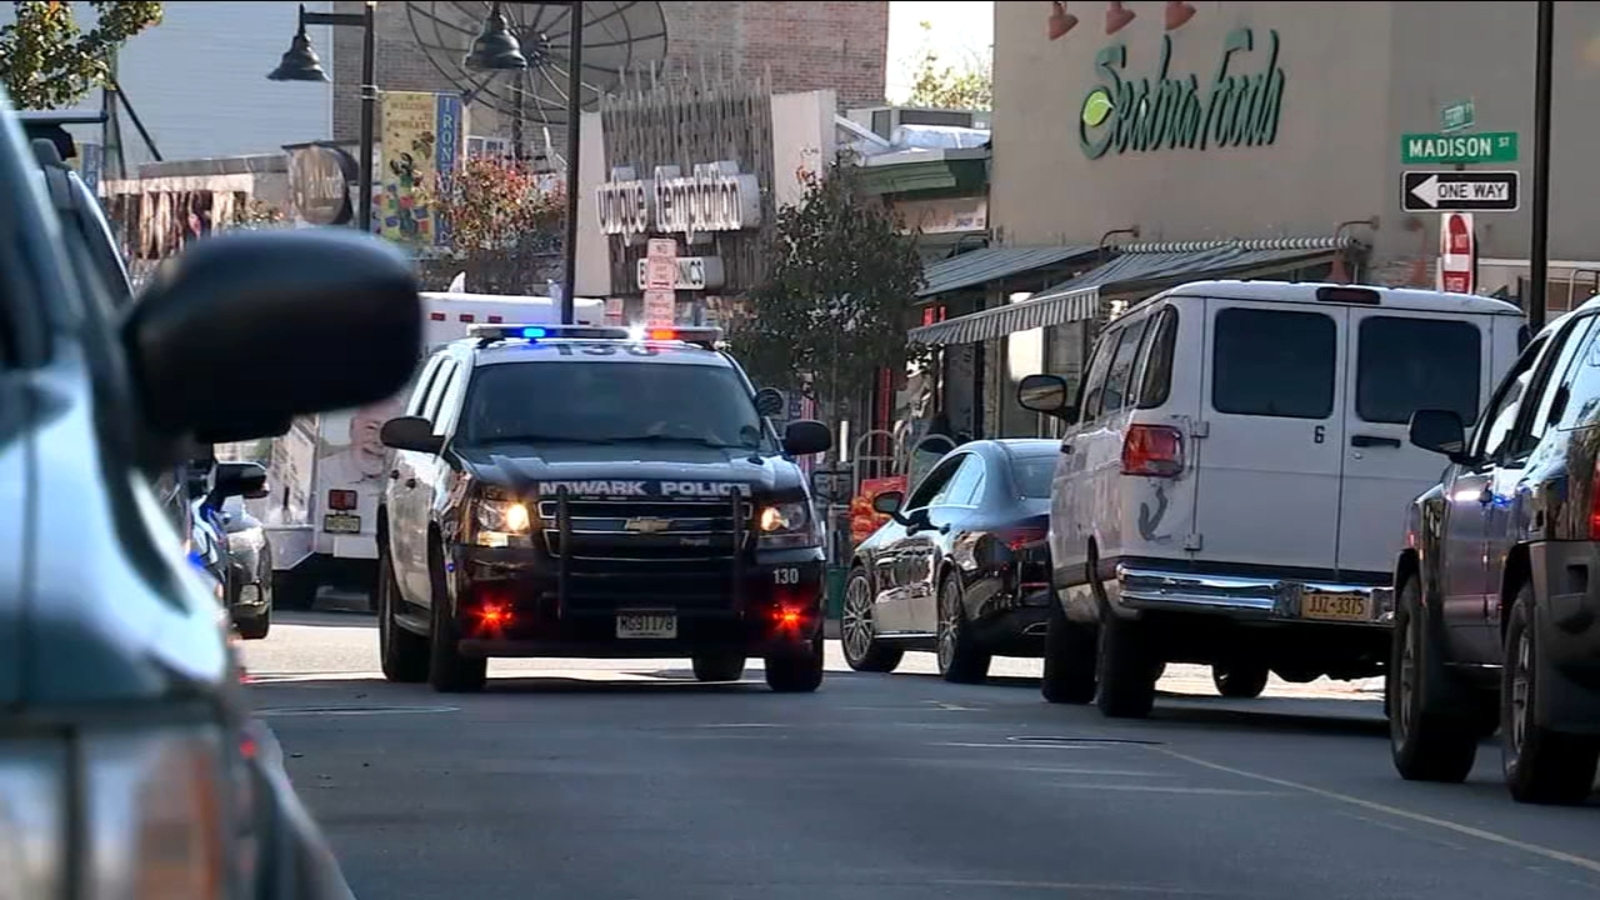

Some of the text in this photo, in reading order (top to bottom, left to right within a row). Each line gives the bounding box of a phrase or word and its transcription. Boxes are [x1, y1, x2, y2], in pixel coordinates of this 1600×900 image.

[1080, 28, 1285, 160] Seabra Foods
[1409, 137, 1510, 158] MADISON ST
[1438, 184, 1506, 199] ONE WAY
[596, 161, 742, 247] unique temptation
[1314, 425, 1325, 444] 6
[773, 568, 799, 584] 130
